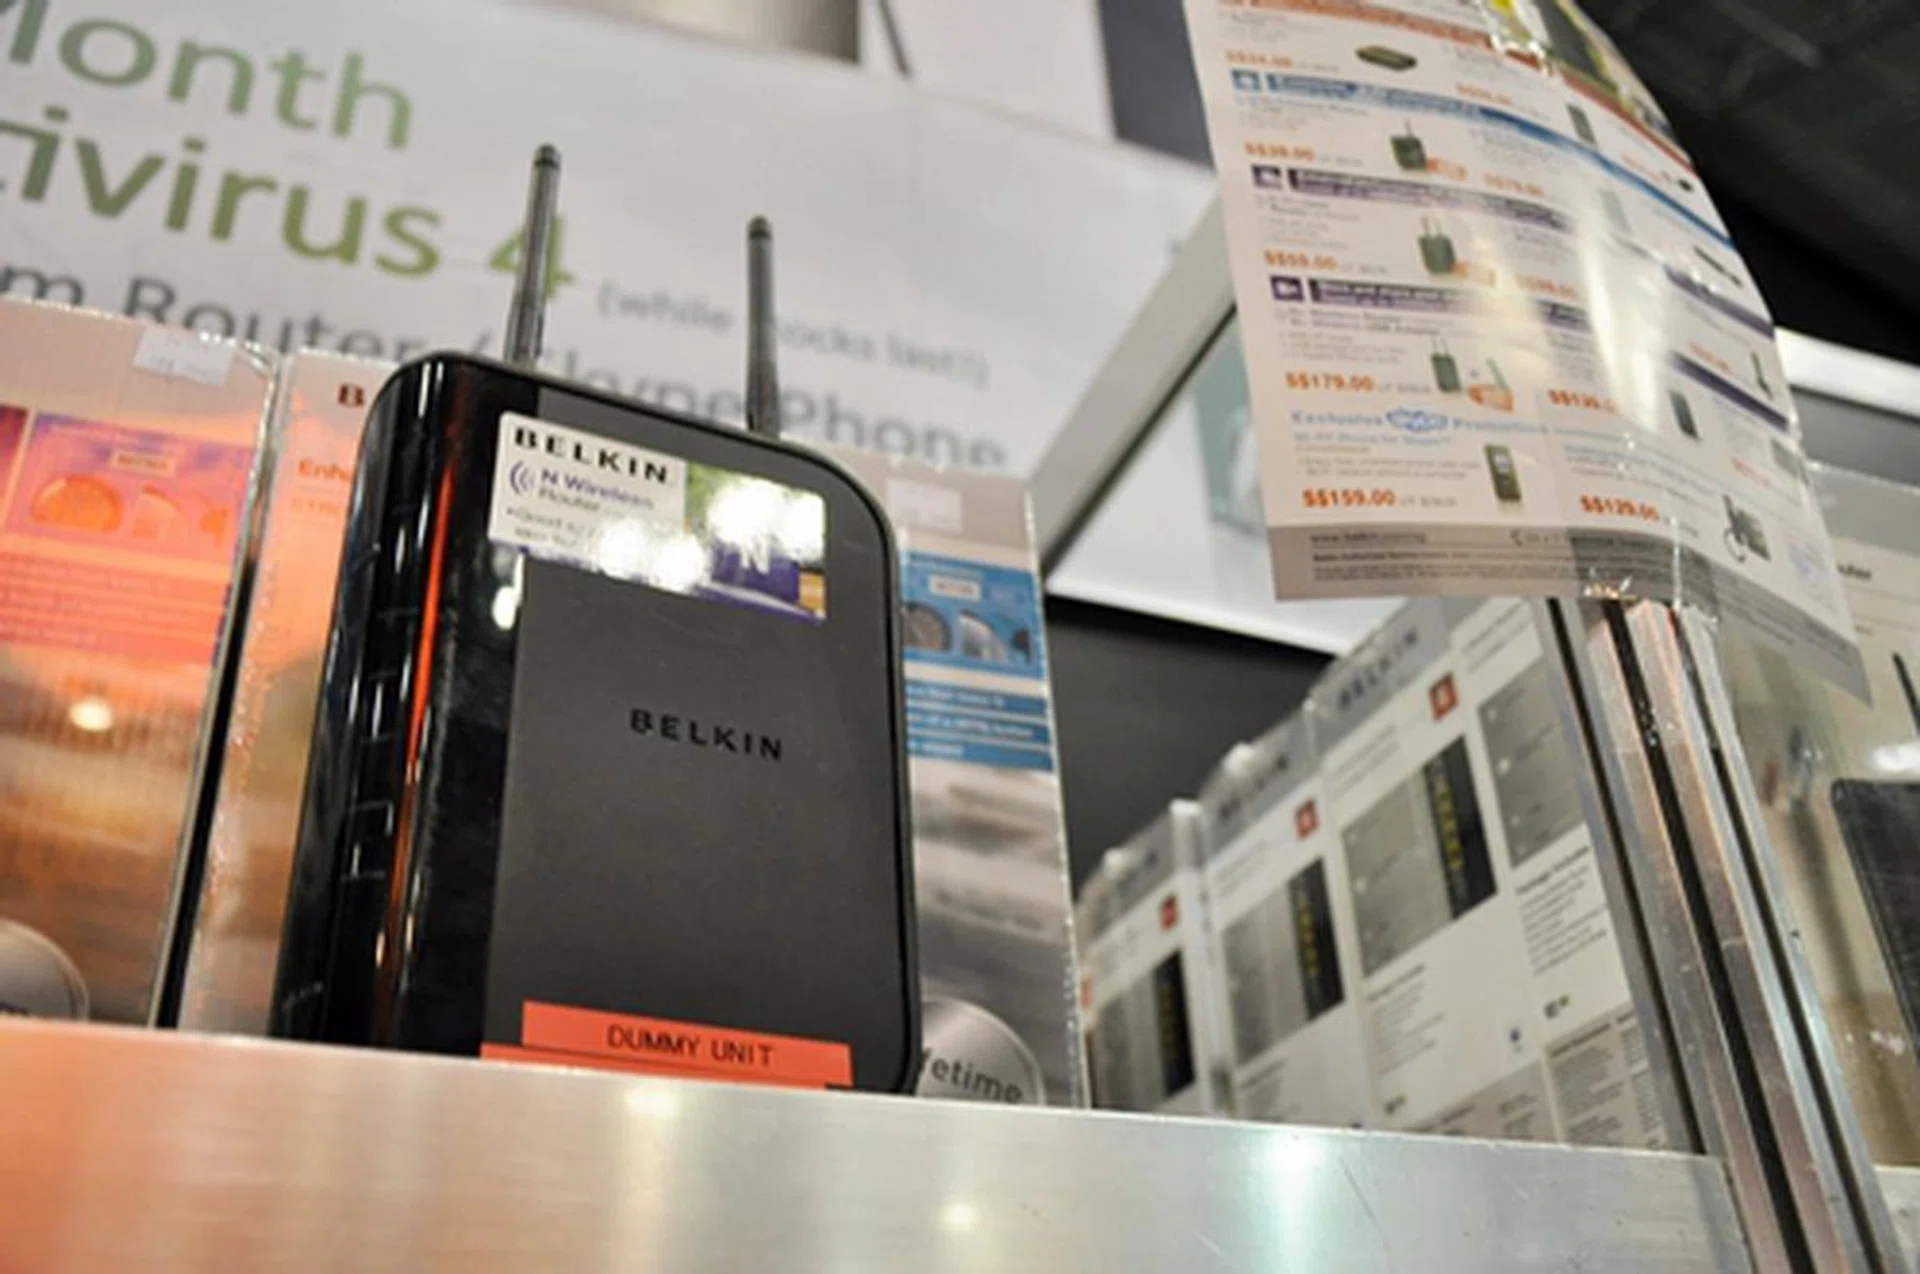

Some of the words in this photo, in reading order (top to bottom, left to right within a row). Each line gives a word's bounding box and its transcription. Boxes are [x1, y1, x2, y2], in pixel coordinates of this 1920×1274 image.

[0, 106, 443, 279] ivirus
[487, 213, 575, 300] 4
[777, 315, 878, 363] ocks
[514, 427, 668, 485] BELKIN
[777, 387, 1009, 470] Phone
[564, 473, 655, 509] Wireless
[629, 707, 783, 762] BELKIN
[607, 1023, 700, 1057] DUMMY
[711, 1038, 774, 1068] UNIT
[922, 1047, 1026, 1103] etime
